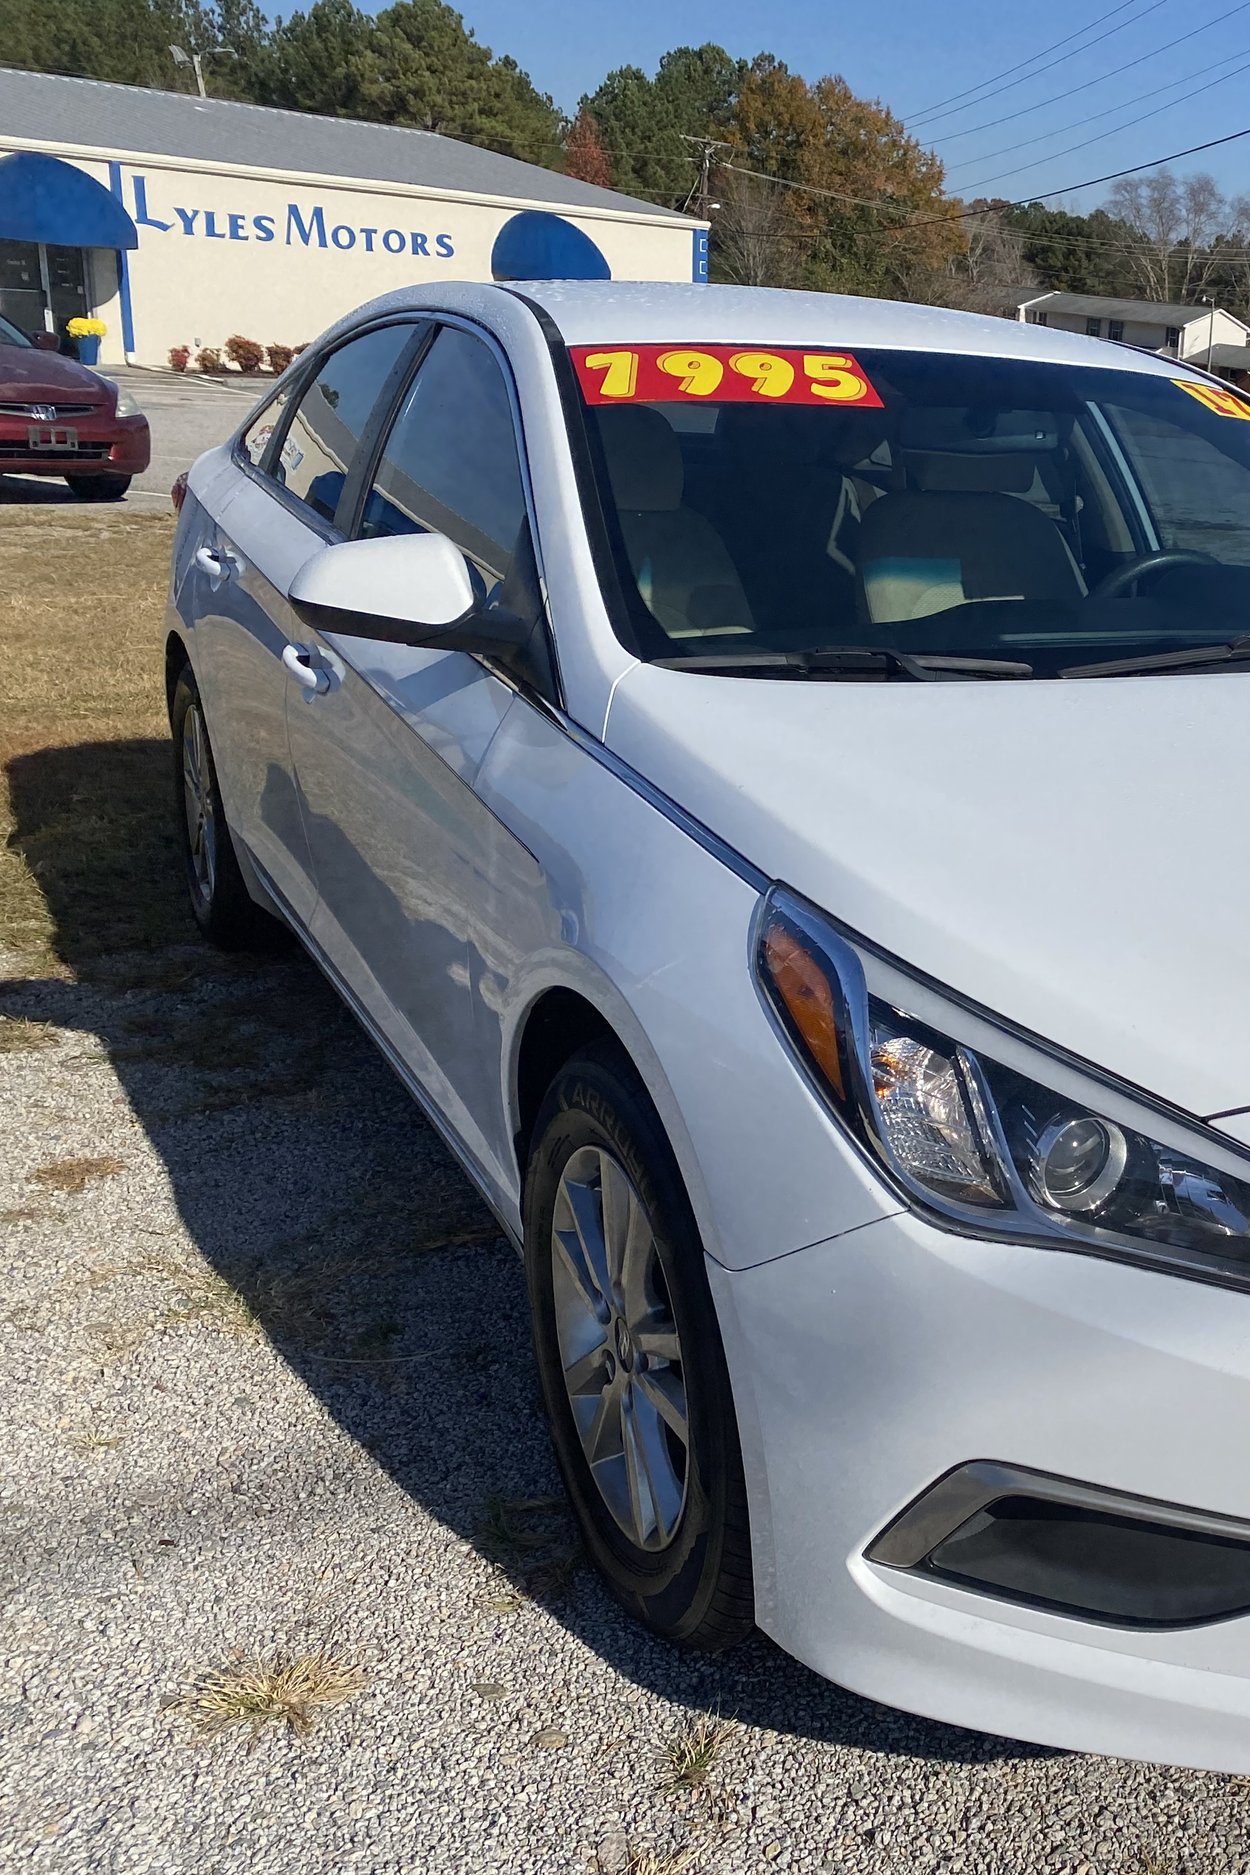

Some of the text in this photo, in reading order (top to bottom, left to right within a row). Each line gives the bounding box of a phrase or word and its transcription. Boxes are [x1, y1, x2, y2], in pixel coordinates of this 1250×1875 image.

[131, 175, 455, 258] LYLES MOTORS
[585, 350, 868, 400] 7995
